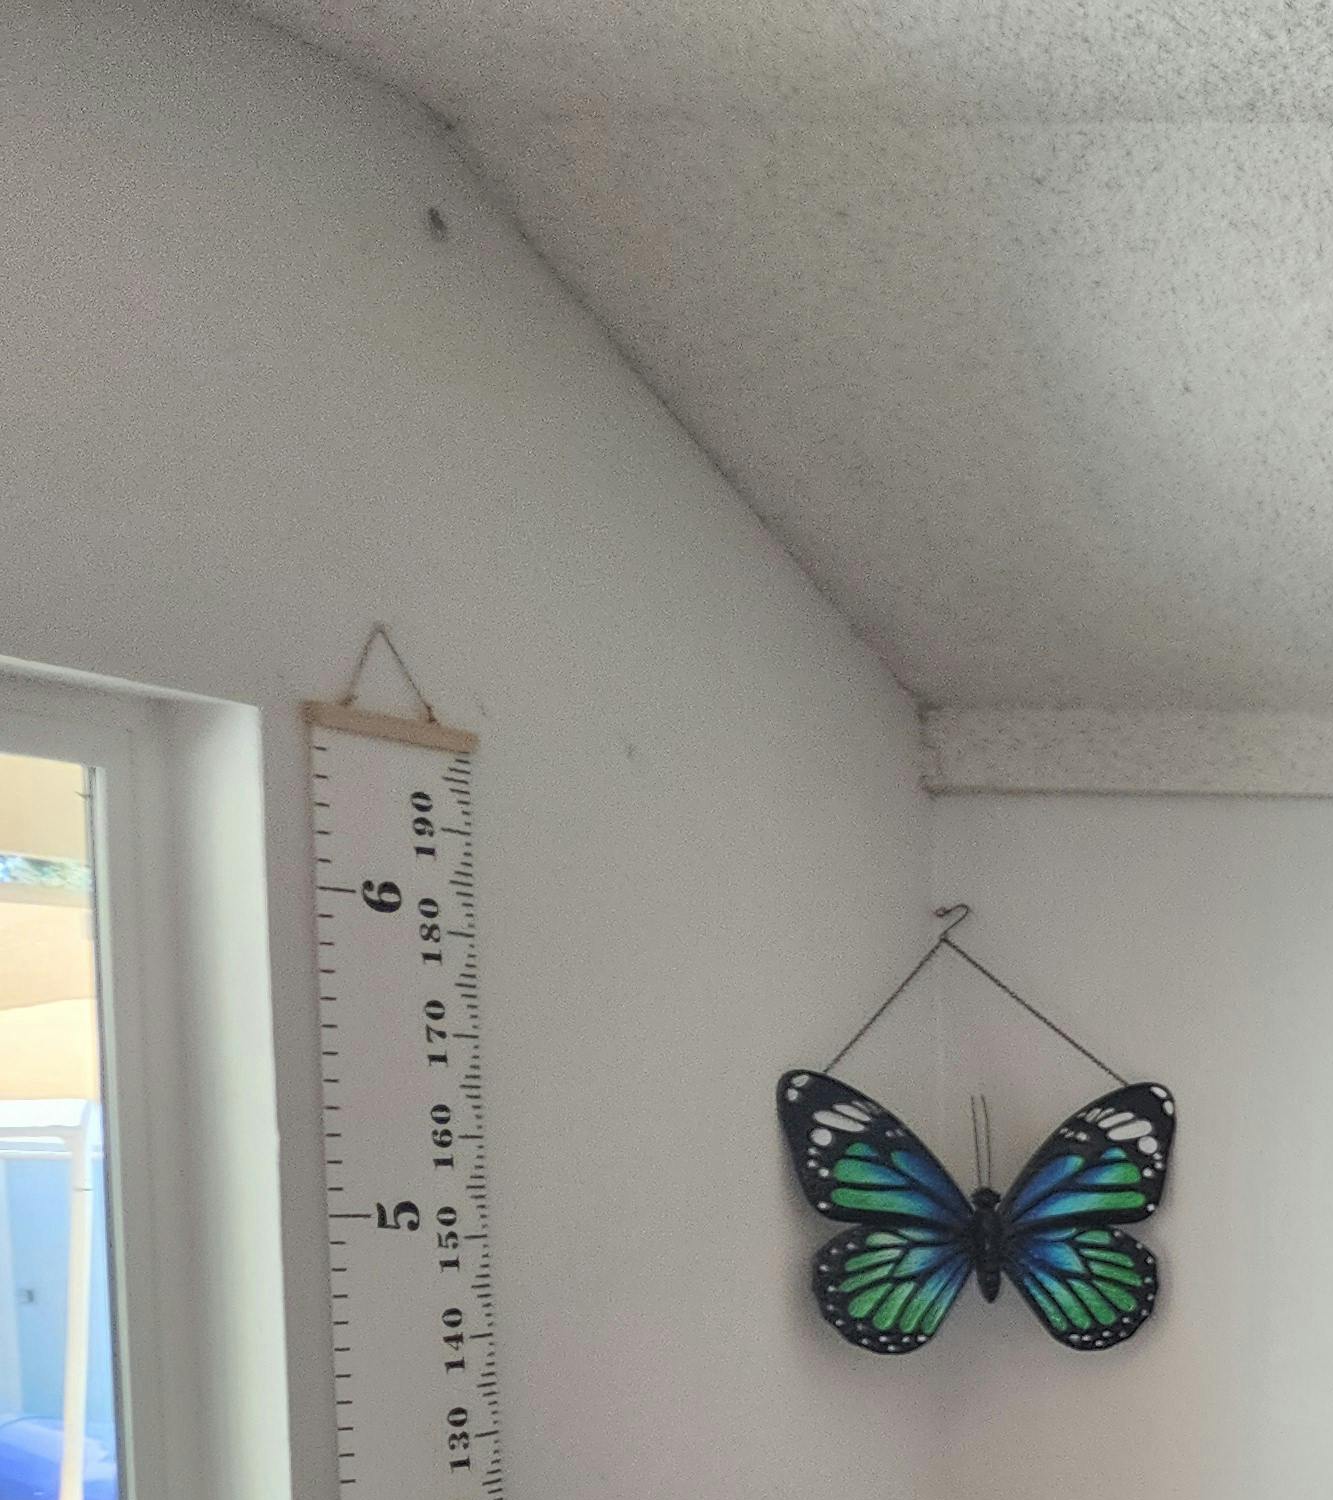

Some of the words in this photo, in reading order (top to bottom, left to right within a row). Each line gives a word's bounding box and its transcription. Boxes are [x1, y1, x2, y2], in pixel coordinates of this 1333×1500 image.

[411, 791, 436, 857] 190
[362, 880, 402, 913] 6
[419, 897, 442, 963] 180
[425, 999, 449, 1065] 170
[431, 1103, 455, 1168] 160
[377, 1200, 420, 1231] 5
[436, 1206, 461, 1269] 150
[443, 1307, 466, 1372] 140
[448, 1406, 471, 1469] 130
